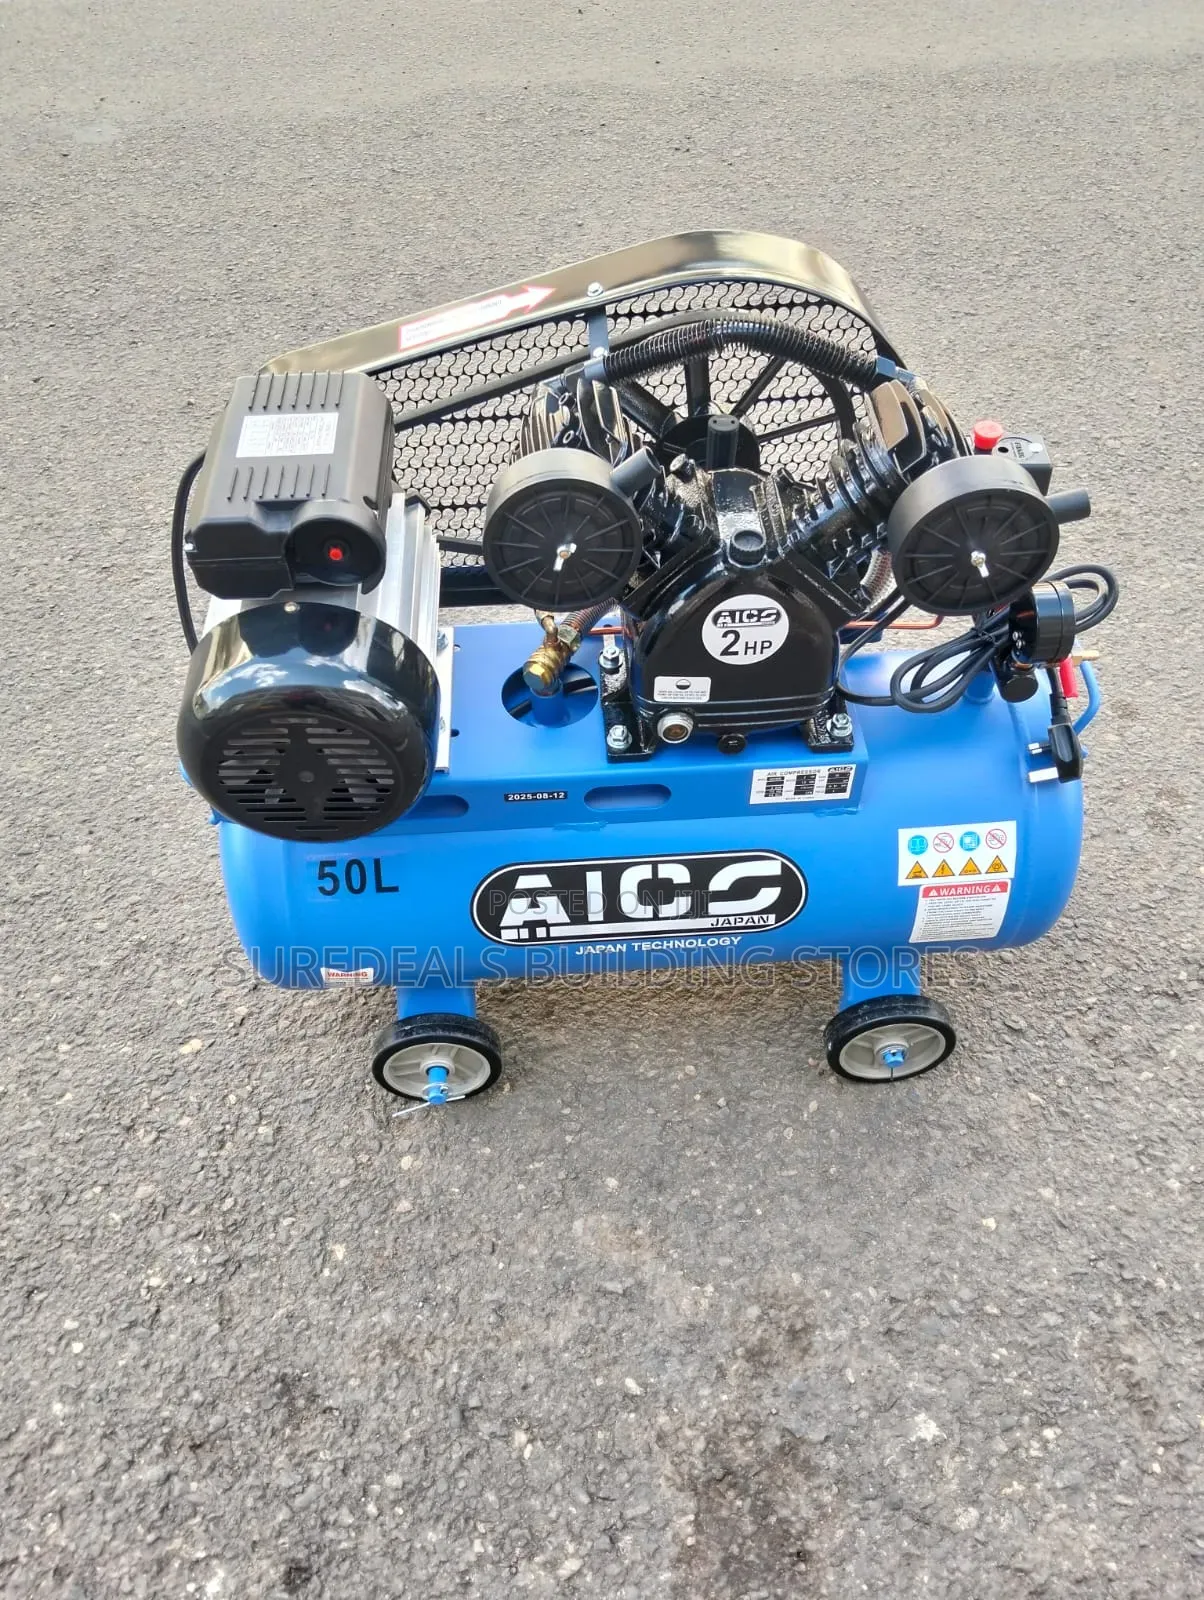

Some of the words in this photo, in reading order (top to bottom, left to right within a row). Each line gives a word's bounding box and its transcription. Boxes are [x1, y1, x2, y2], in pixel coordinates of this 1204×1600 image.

[716, 608, 778, 625] AICS
[507, 792, 566, 801] 2025-08-12
[317, 857, 400, 897] 50L
[499, 859, 782, 927] AICS
[939, 885, 991, 897] WARNING
[710, 915, 770, 928] JAPAN
[575, 943, 627, 956] JAPAN
[631, 935, 743, 952] TECHNOLOGY
